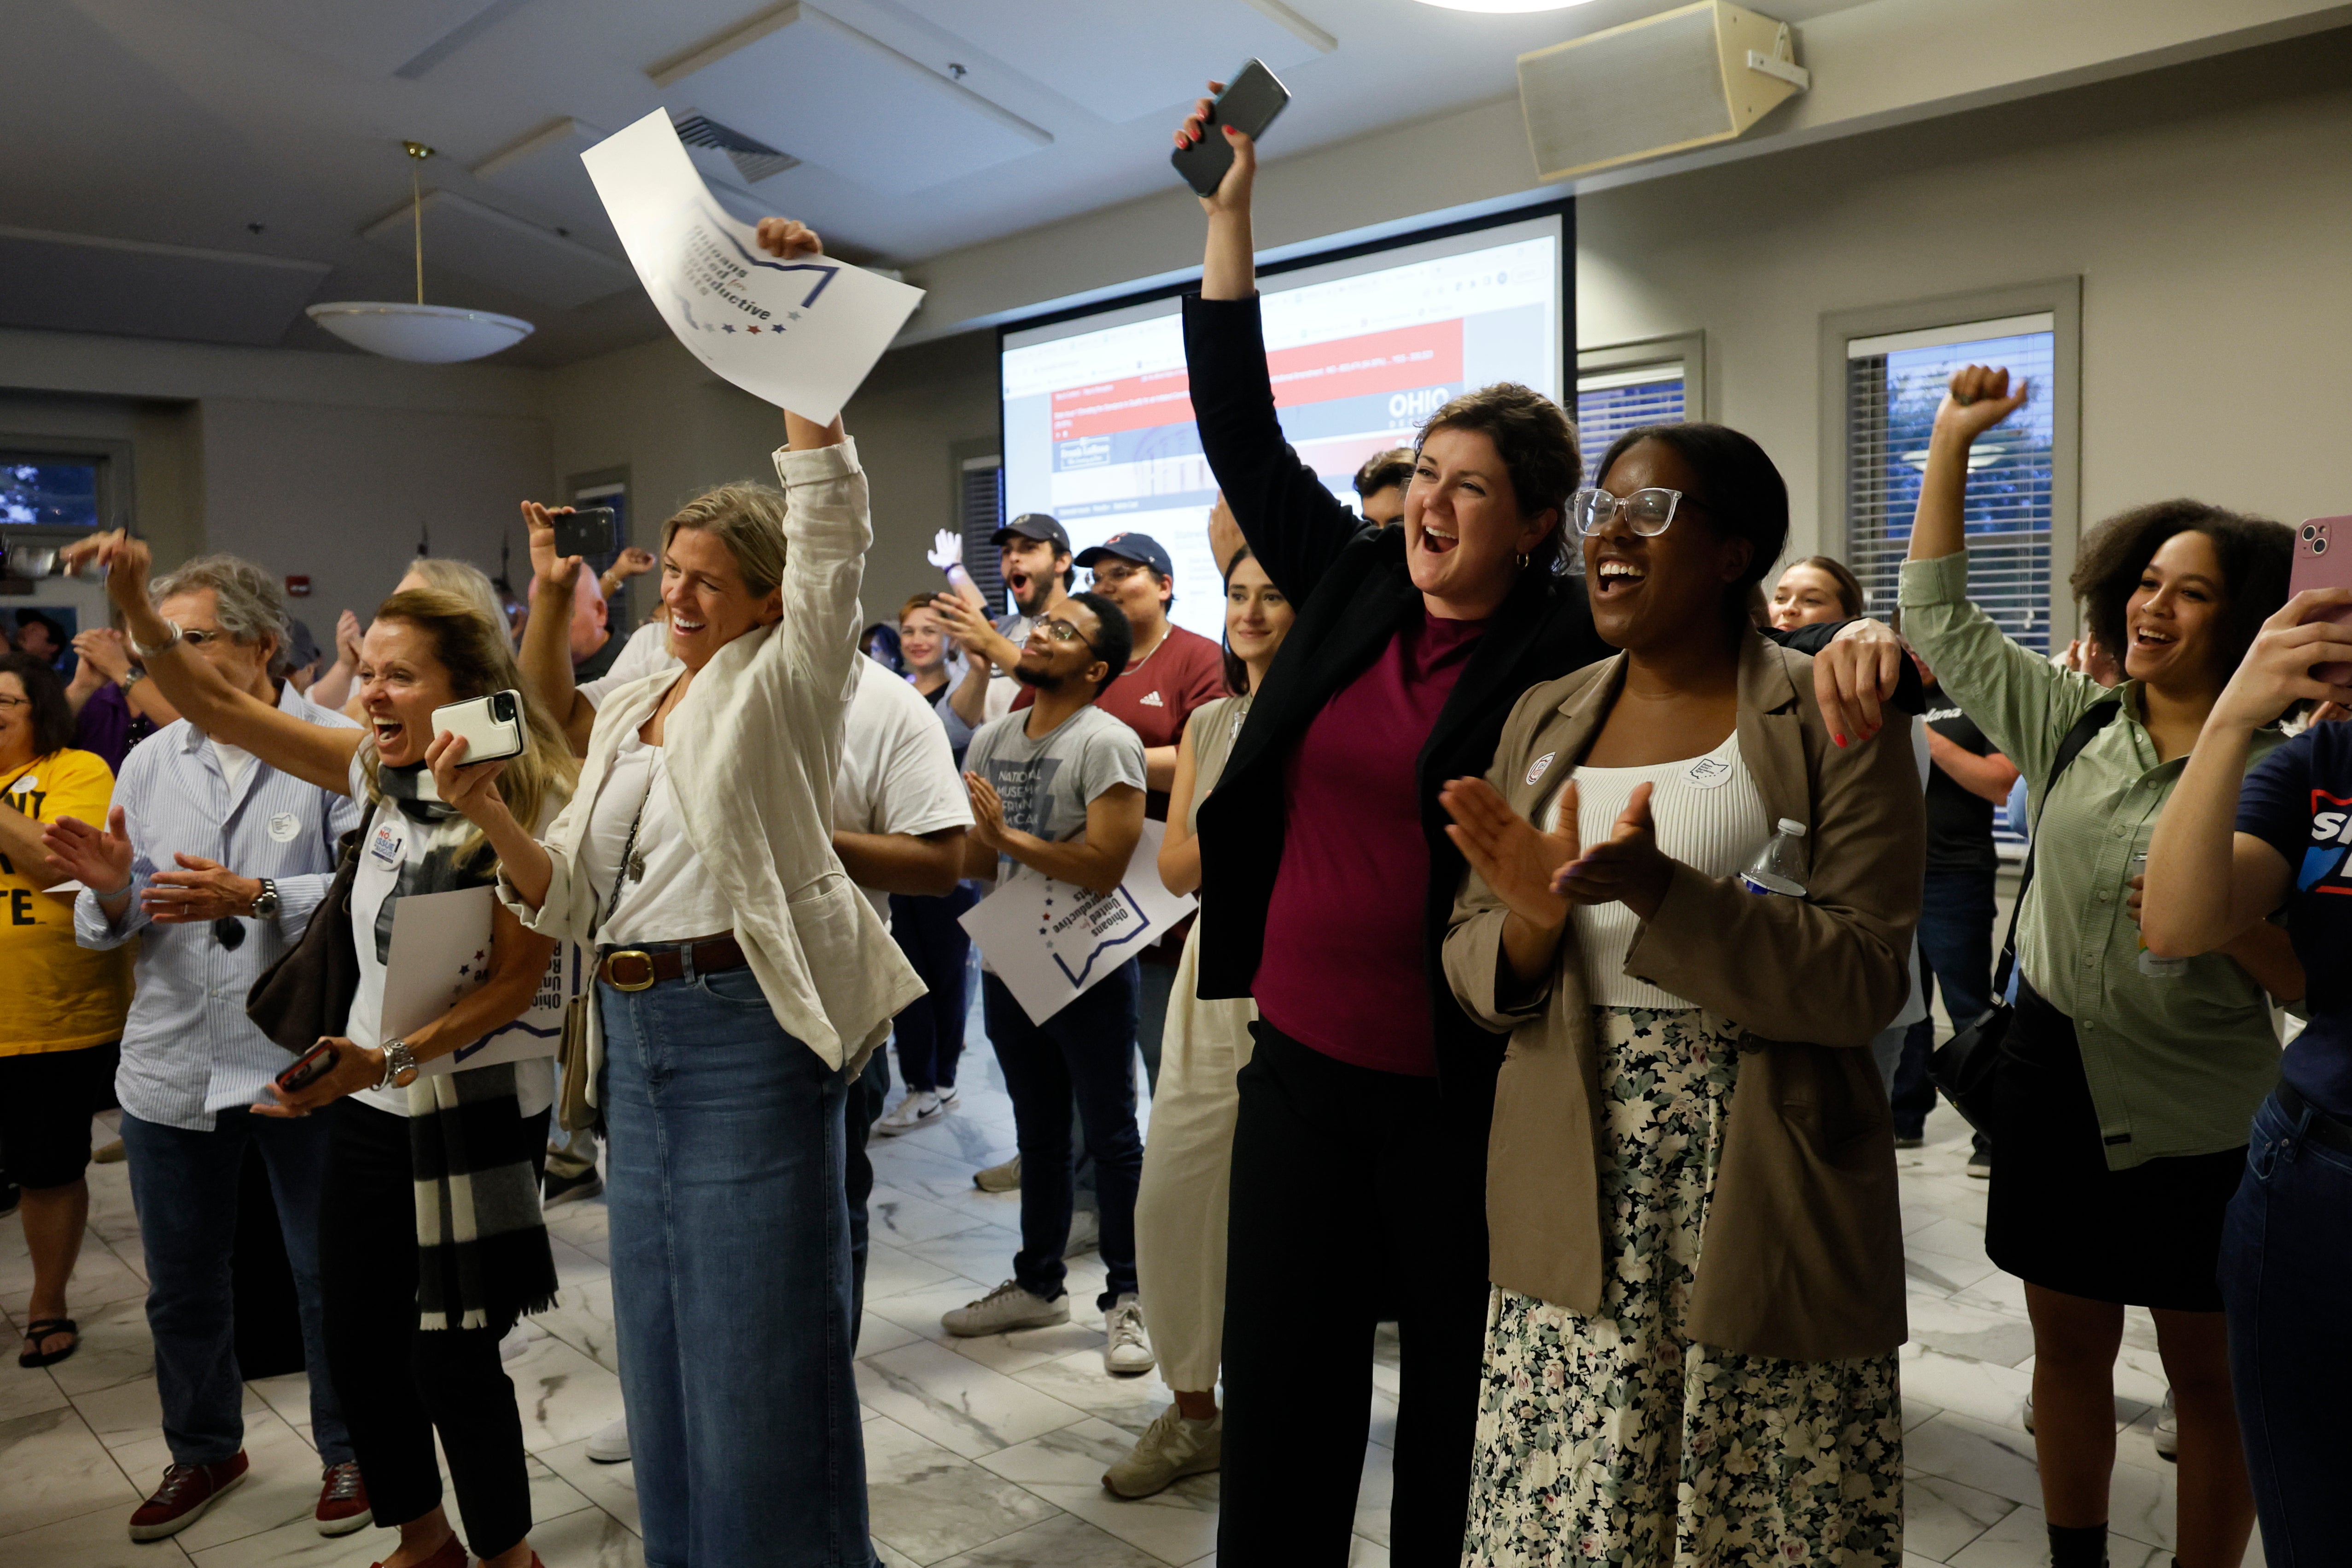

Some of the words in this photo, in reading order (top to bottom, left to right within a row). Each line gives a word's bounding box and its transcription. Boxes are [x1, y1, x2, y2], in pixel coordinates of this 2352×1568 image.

[1389, 387, 1449, 418] OHIO
[998, 769, 1041, 782] NATIOAL
[997, 785, 1033, 798] MUSEM
[379, 829, 390, 839] NO
[394, 838, 402, 852] 1
[0, 889, 35, 925] E
[1089, 898, 1121, 925] United
[1091, 908, 1128, 937] Ohioans
[531, 993, 561, 1010] Ohio
